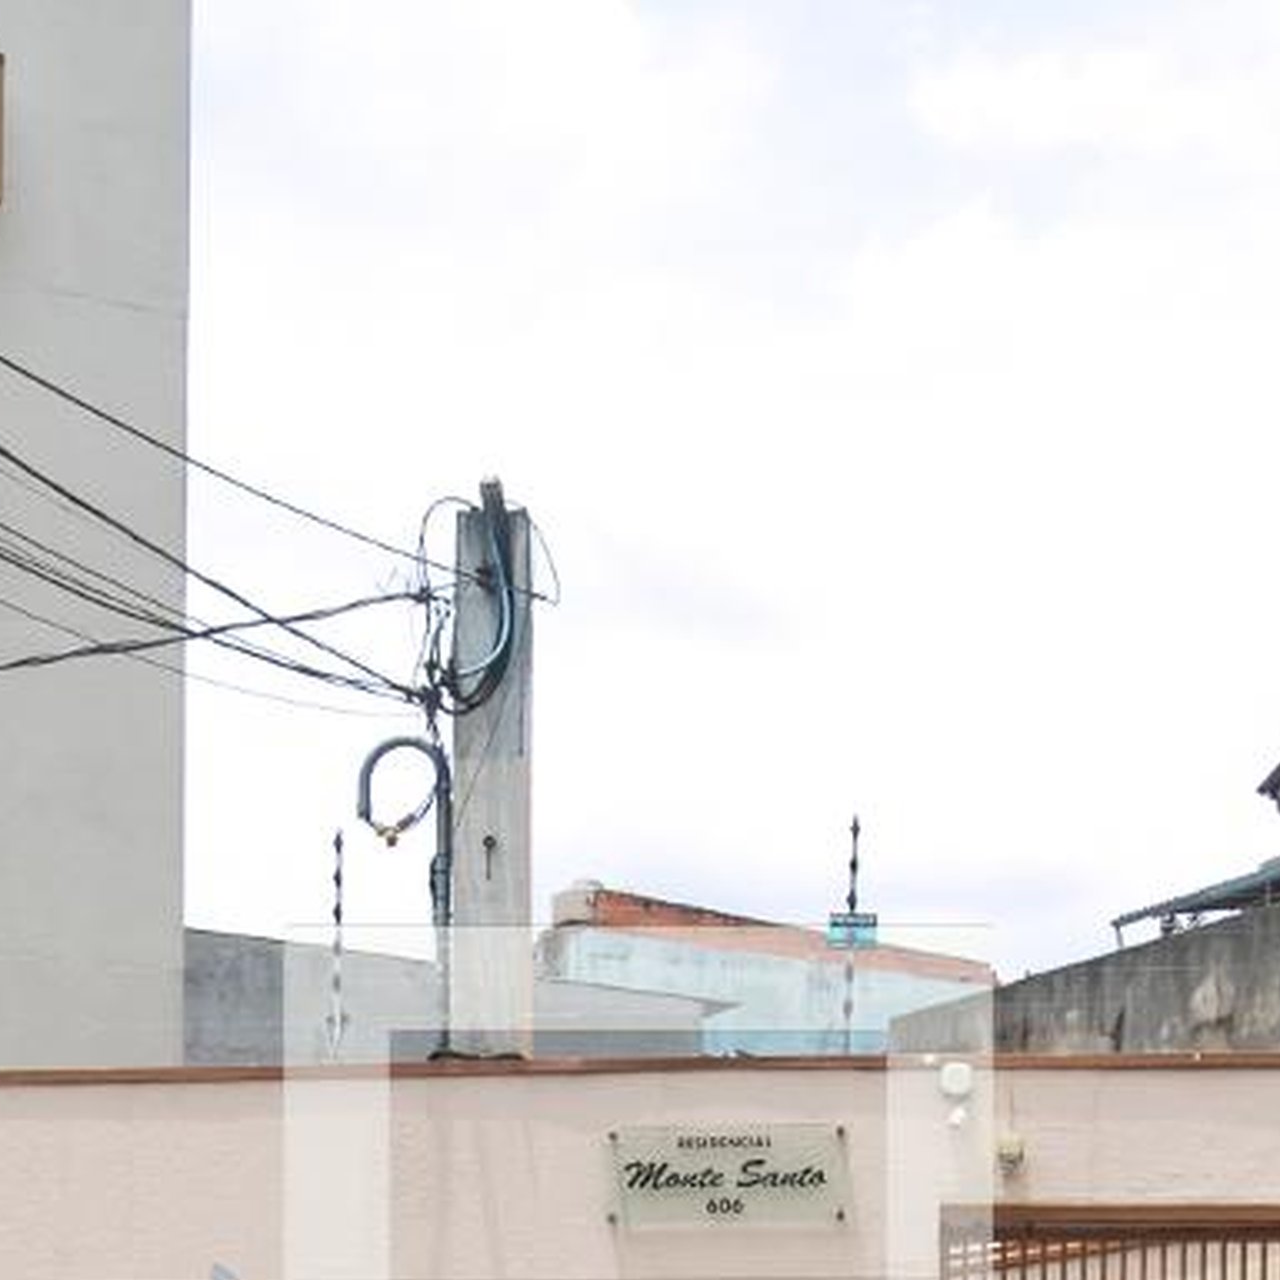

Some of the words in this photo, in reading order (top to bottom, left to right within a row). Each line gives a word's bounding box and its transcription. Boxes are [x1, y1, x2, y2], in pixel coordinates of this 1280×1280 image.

[623, 1161, 725, 1191] Monte
[735, 1158, 828, 1189] Santo
[706, 1197, 745, 1215] 606
